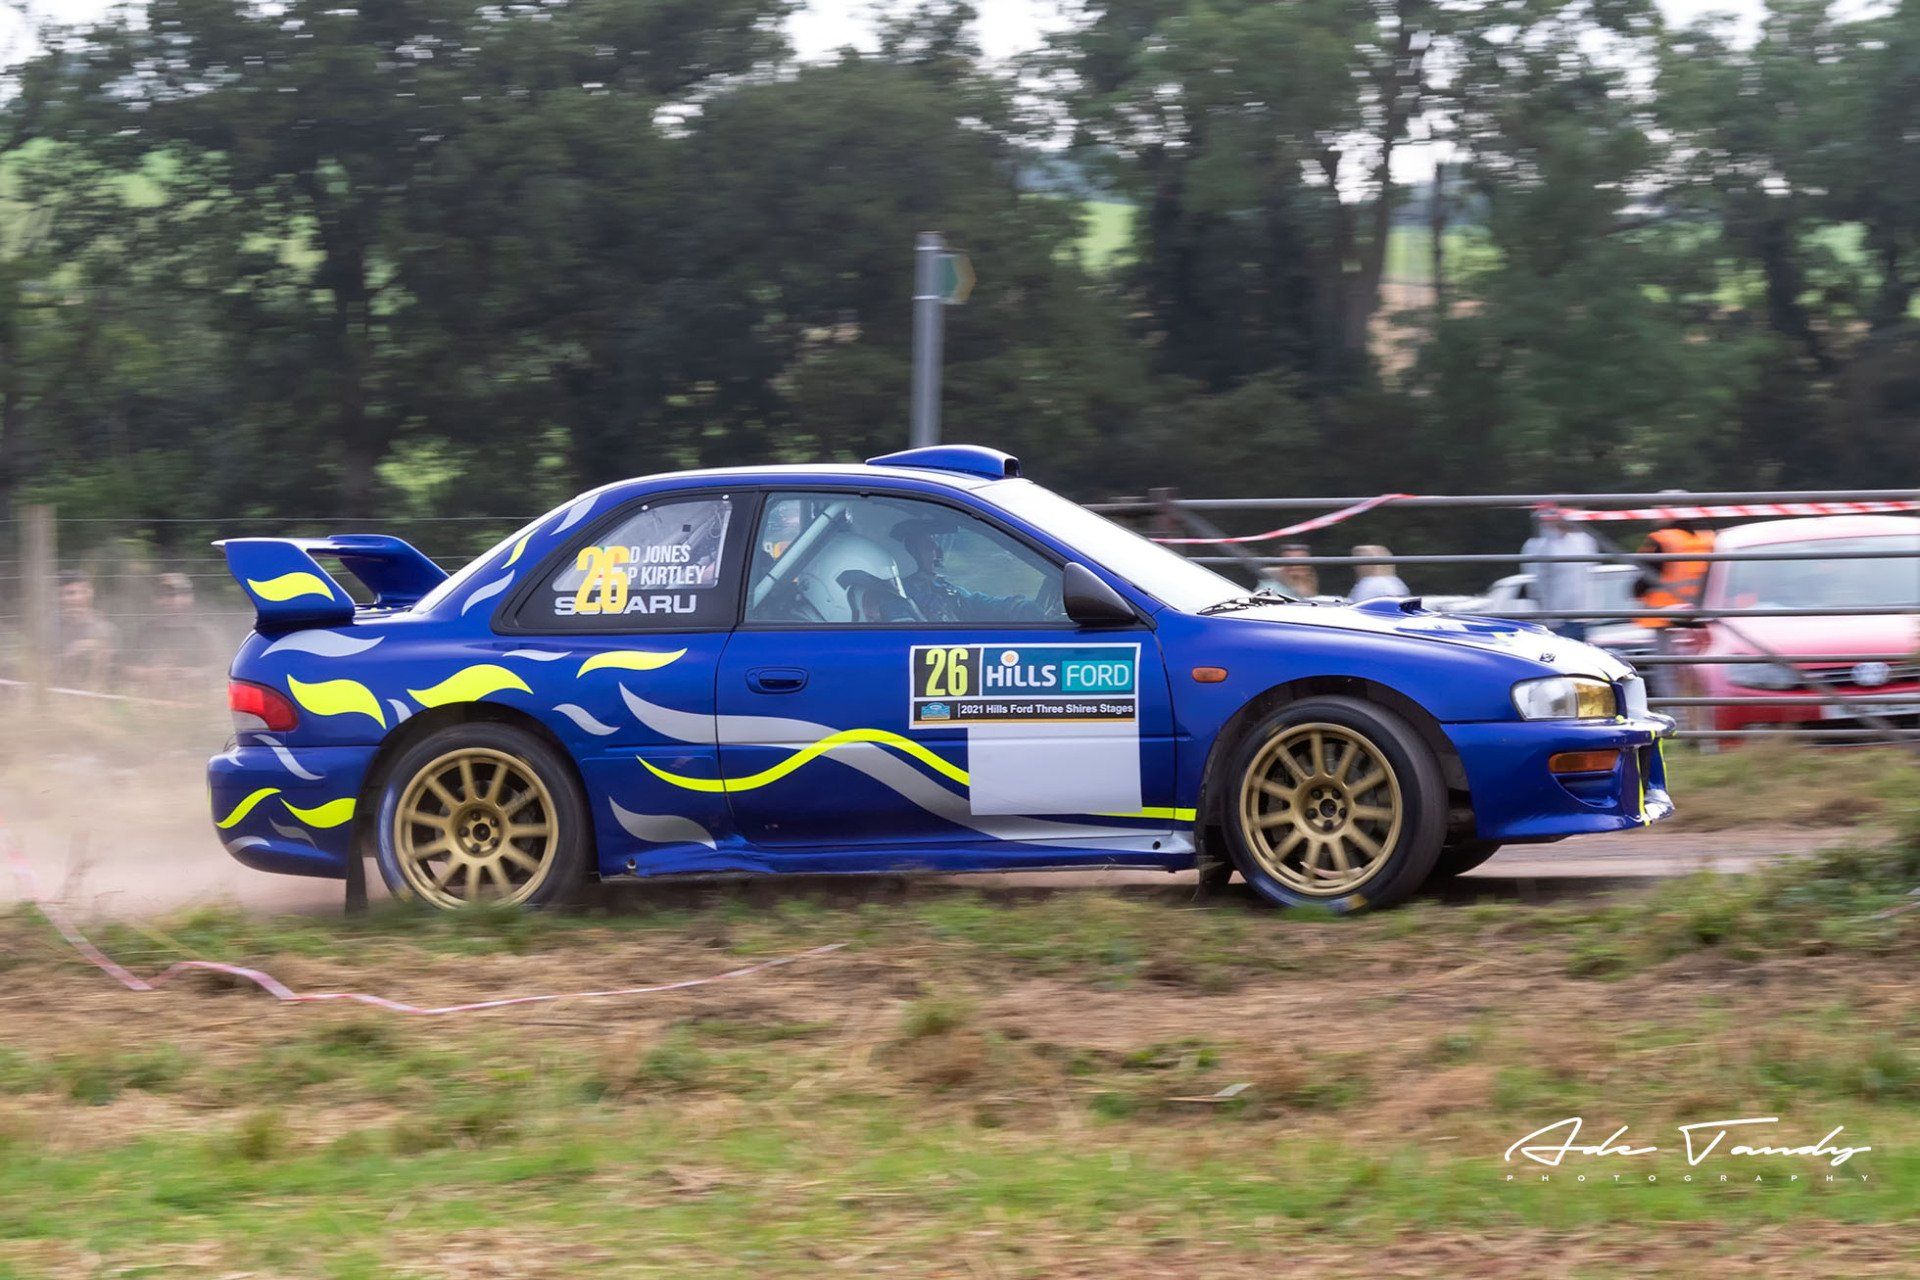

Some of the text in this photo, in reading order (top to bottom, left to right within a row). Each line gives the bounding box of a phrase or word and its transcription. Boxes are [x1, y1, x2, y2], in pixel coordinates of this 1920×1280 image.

[630, 545, 691, 563] D JONES
[575, 546, 630, 612] 26
[628, 565, 706, 585] P KIRTLEY
[925, 648, 969, 697] 26
[1066, 665, 1129, 687] FORD
[961, 703, 1134, 715] 2021 Hills Ford Three Shires Stages
